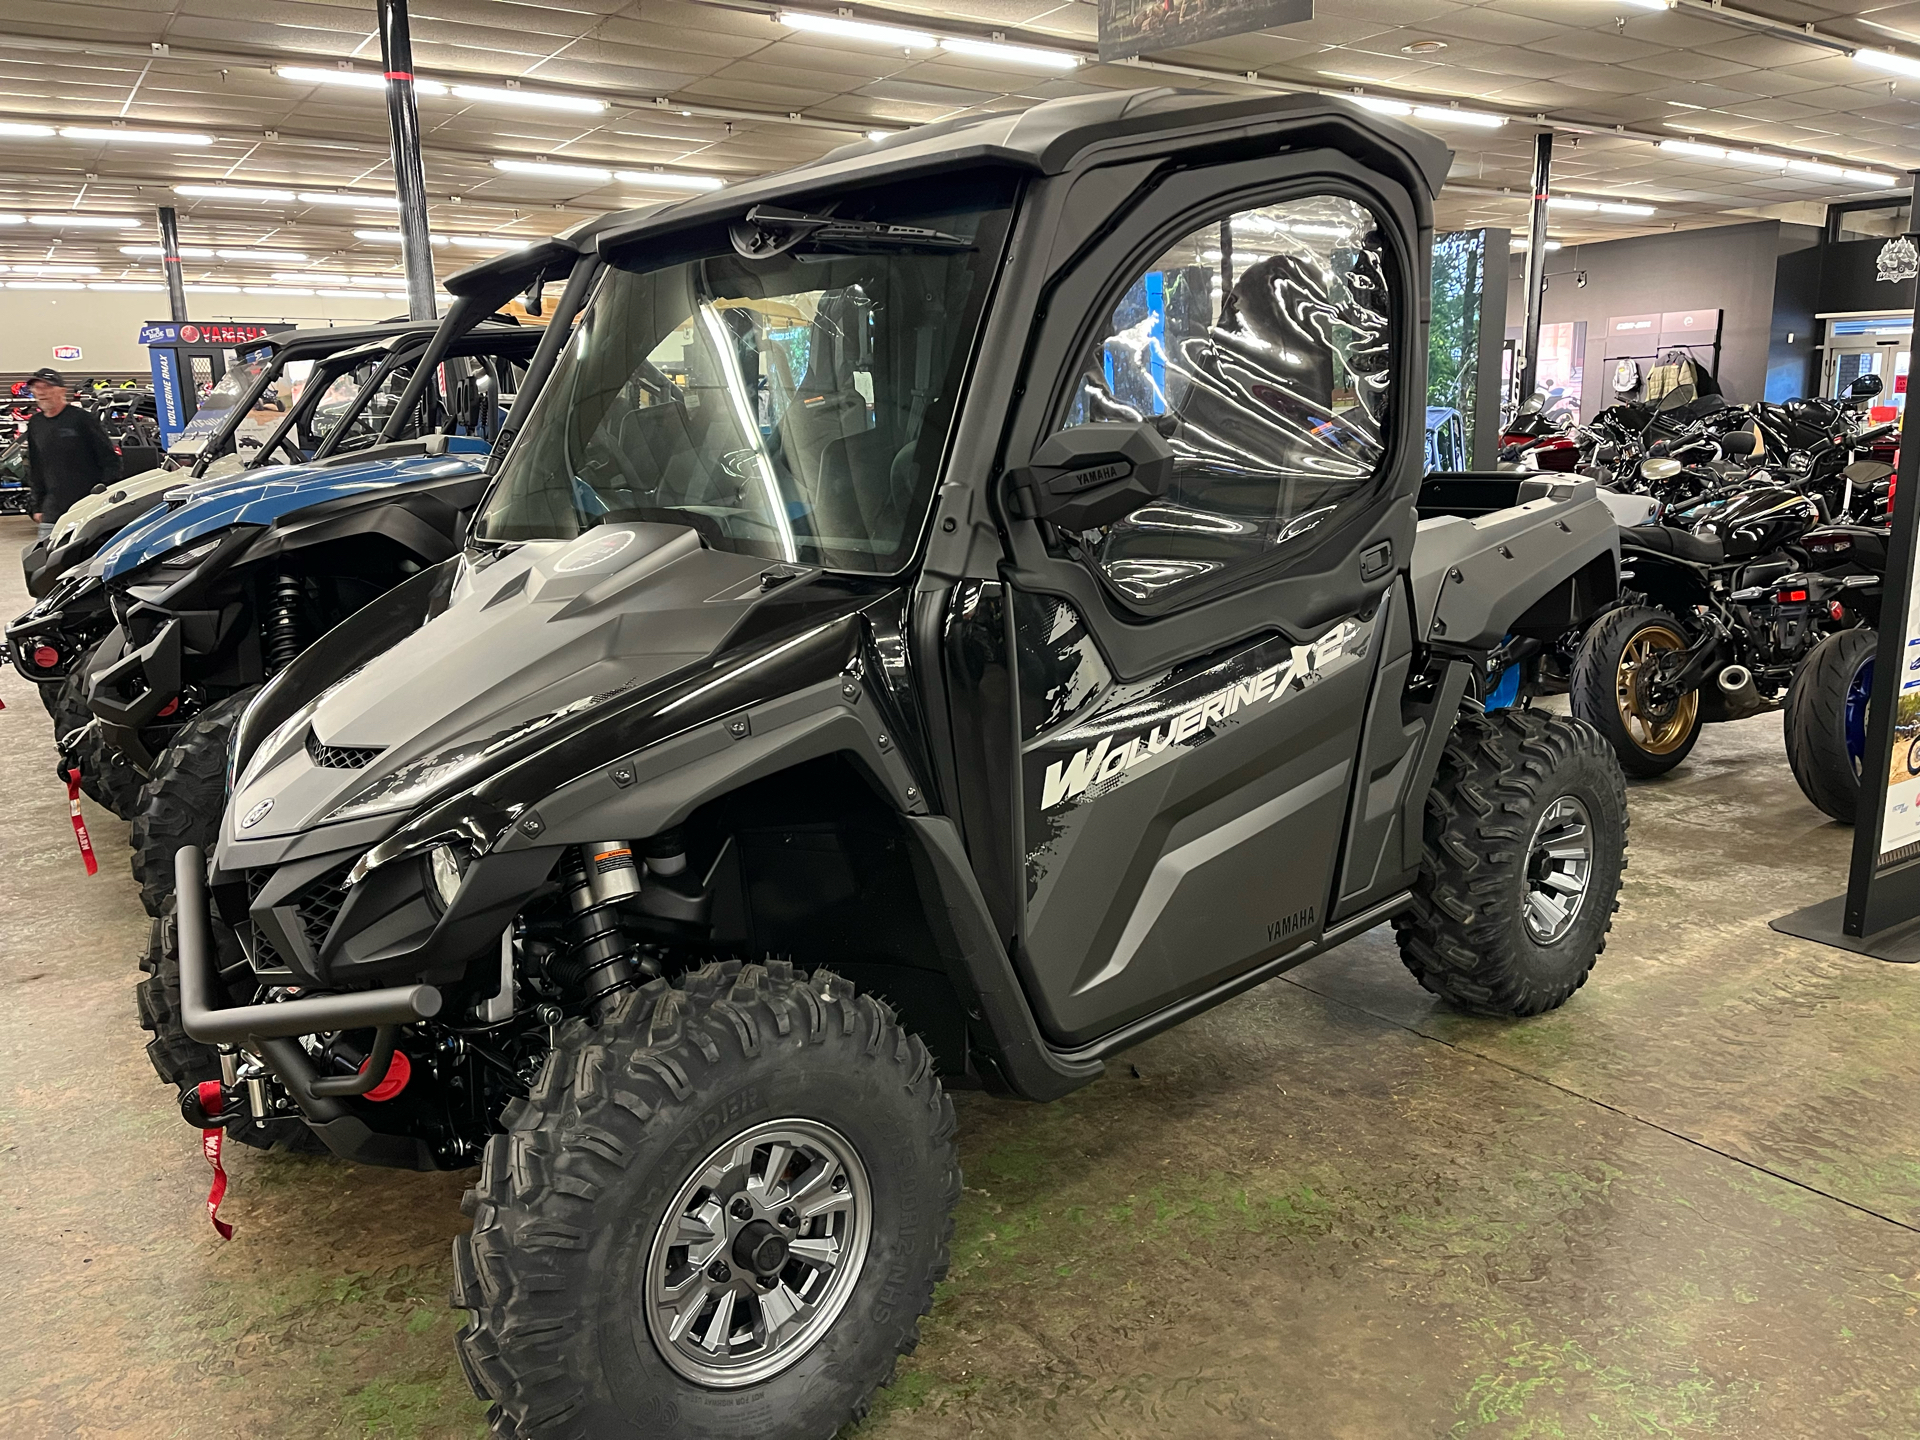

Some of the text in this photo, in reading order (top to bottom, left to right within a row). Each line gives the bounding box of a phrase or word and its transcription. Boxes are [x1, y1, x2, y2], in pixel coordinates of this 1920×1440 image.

[200, 325, 268, 343] YAMAHA
[56, 348, 79, 358] 100%
[158, 354, 178, 427] WOLVERINE RMAX
[1076, 465, 1118, 486] YAMAHA
[76, 826, 91, 851] WARN
[1266, 905, 1315, 943] YAMAHA
[872, 1264, 908, 1325] NHS
